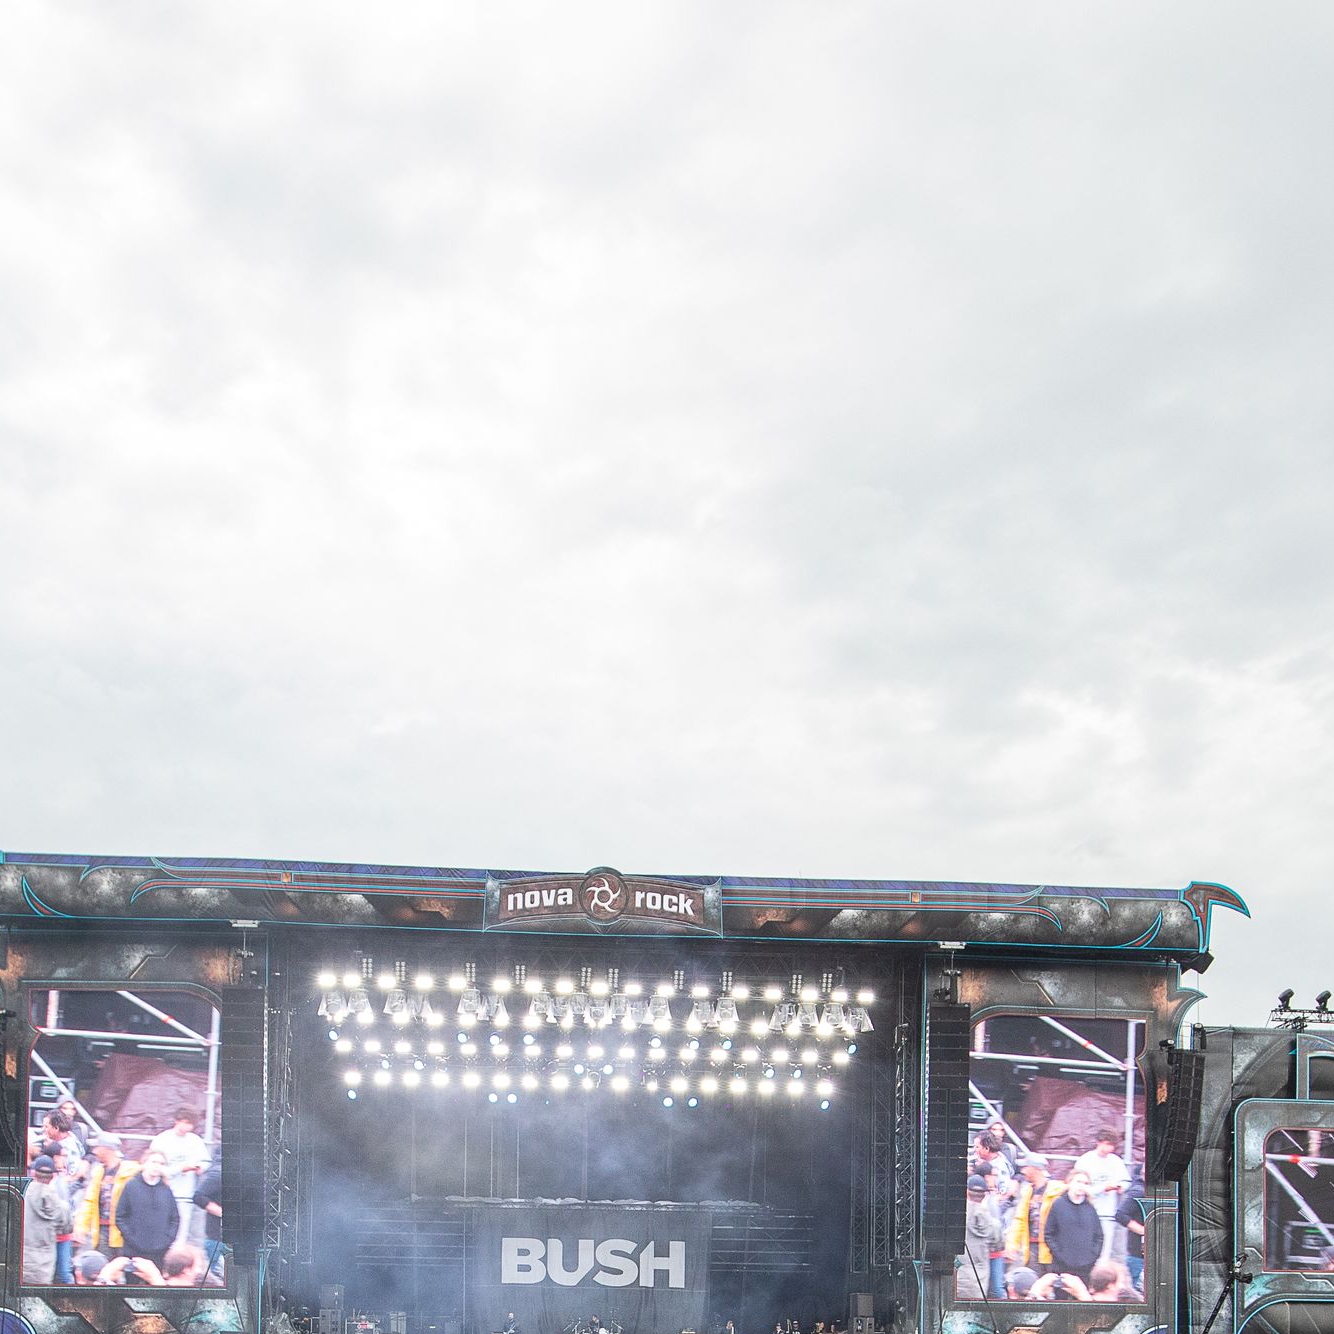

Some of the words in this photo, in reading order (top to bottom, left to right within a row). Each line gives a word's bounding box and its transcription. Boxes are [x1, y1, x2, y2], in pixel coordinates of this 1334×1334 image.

[507, 888, 573, 911] nova
[635, 891, 695, 916] rock
[501, 1237, 686, 1288] BUSH
